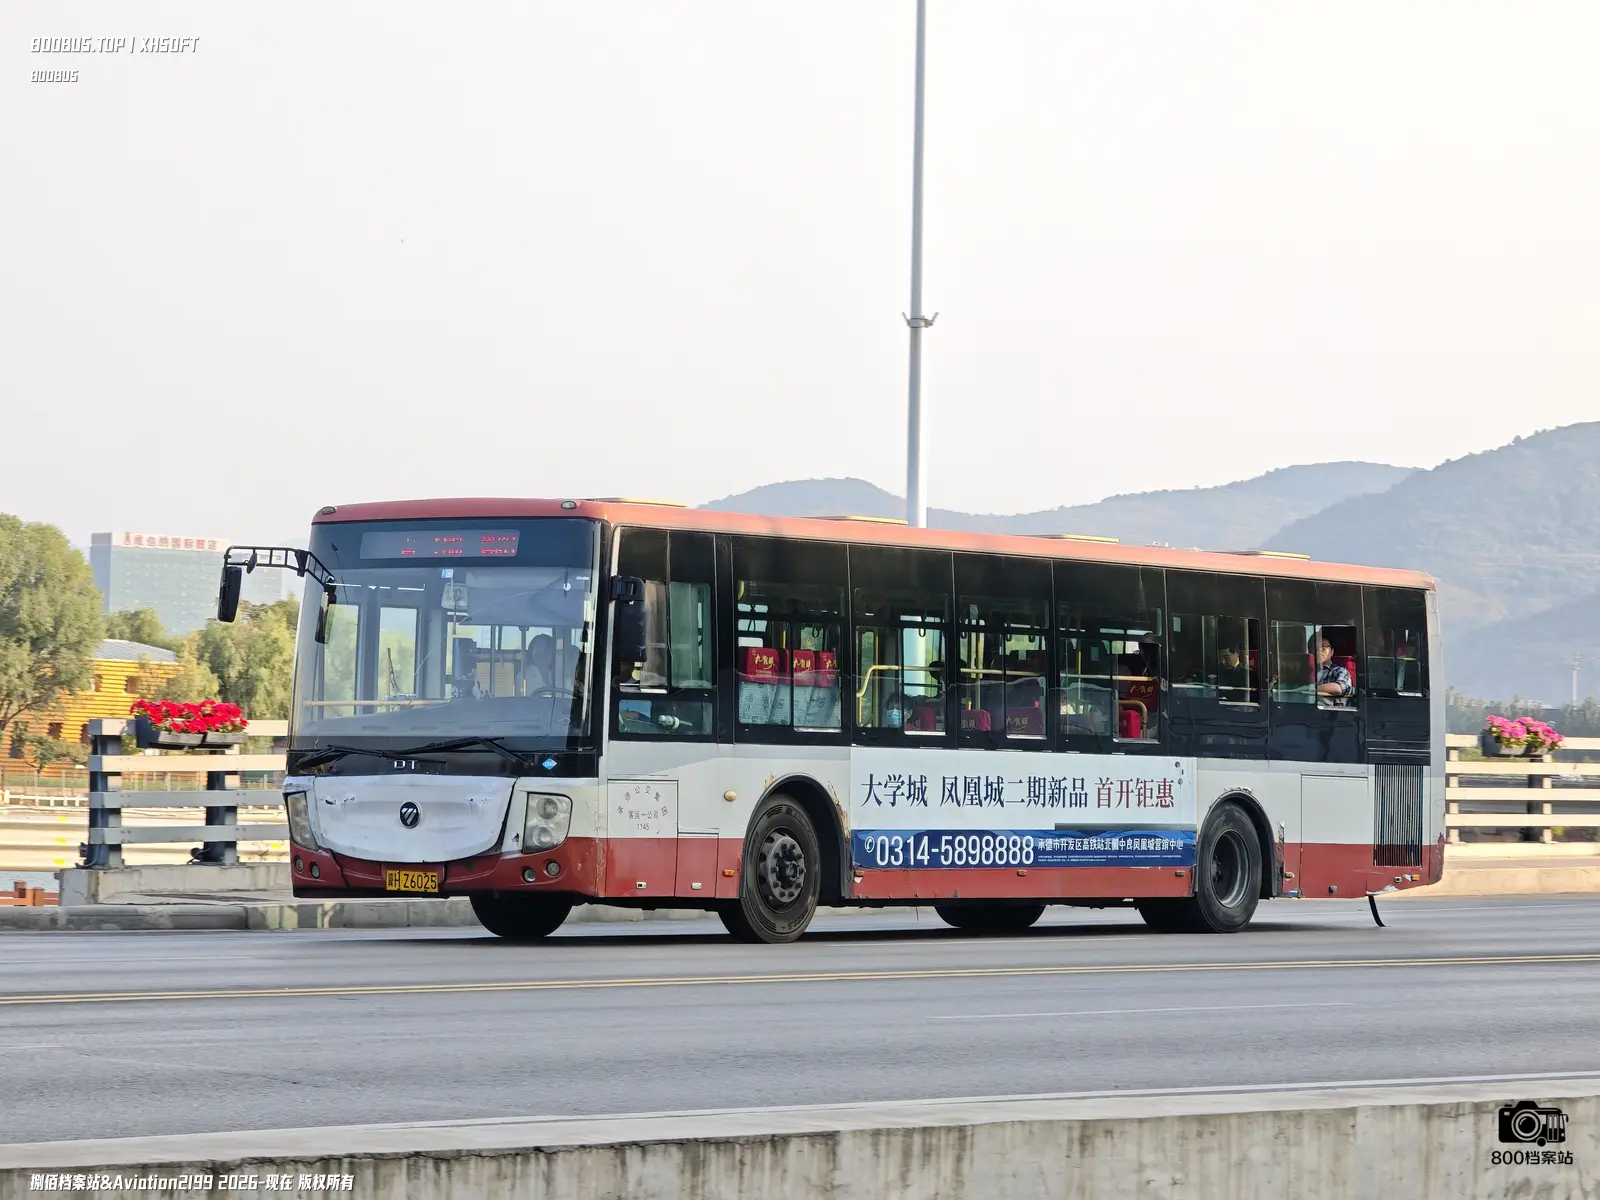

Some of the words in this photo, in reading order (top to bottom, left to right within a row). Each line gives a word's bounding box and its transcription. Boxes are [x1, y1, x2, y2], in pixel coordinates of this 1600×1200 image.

[861, 773, 928, 808] 大学城
[939, 775, 1089, 809] 凤凰城二期新品
[1094, 776, 1175, 809] 首开钜惠
[876, 835, 1034, 866] 0314-5898888
